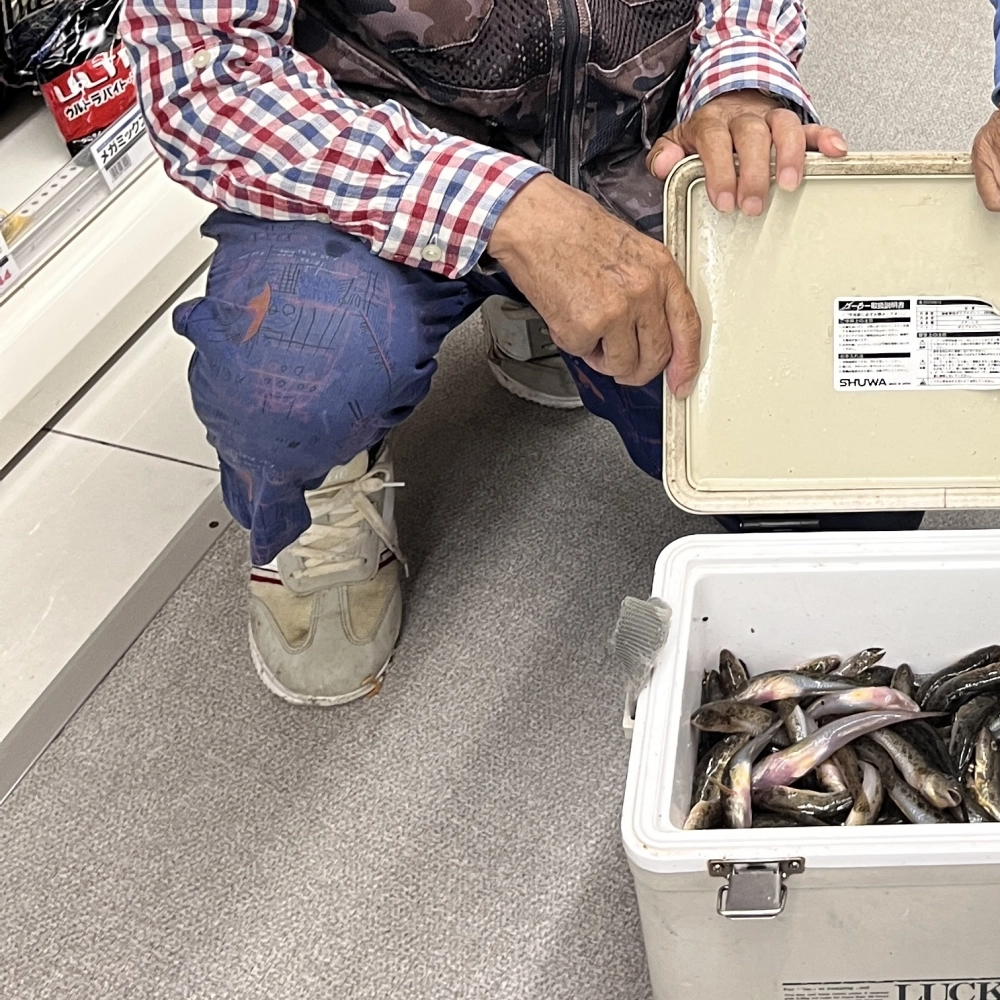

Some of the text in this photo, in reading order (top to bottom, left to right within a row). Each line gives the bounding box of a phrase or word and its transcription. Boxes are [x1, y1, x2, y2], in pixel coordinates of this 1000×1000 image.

[65, 72, 134, 120] ウルトラバイト
[839, 378, 887, 387] SHUWA
